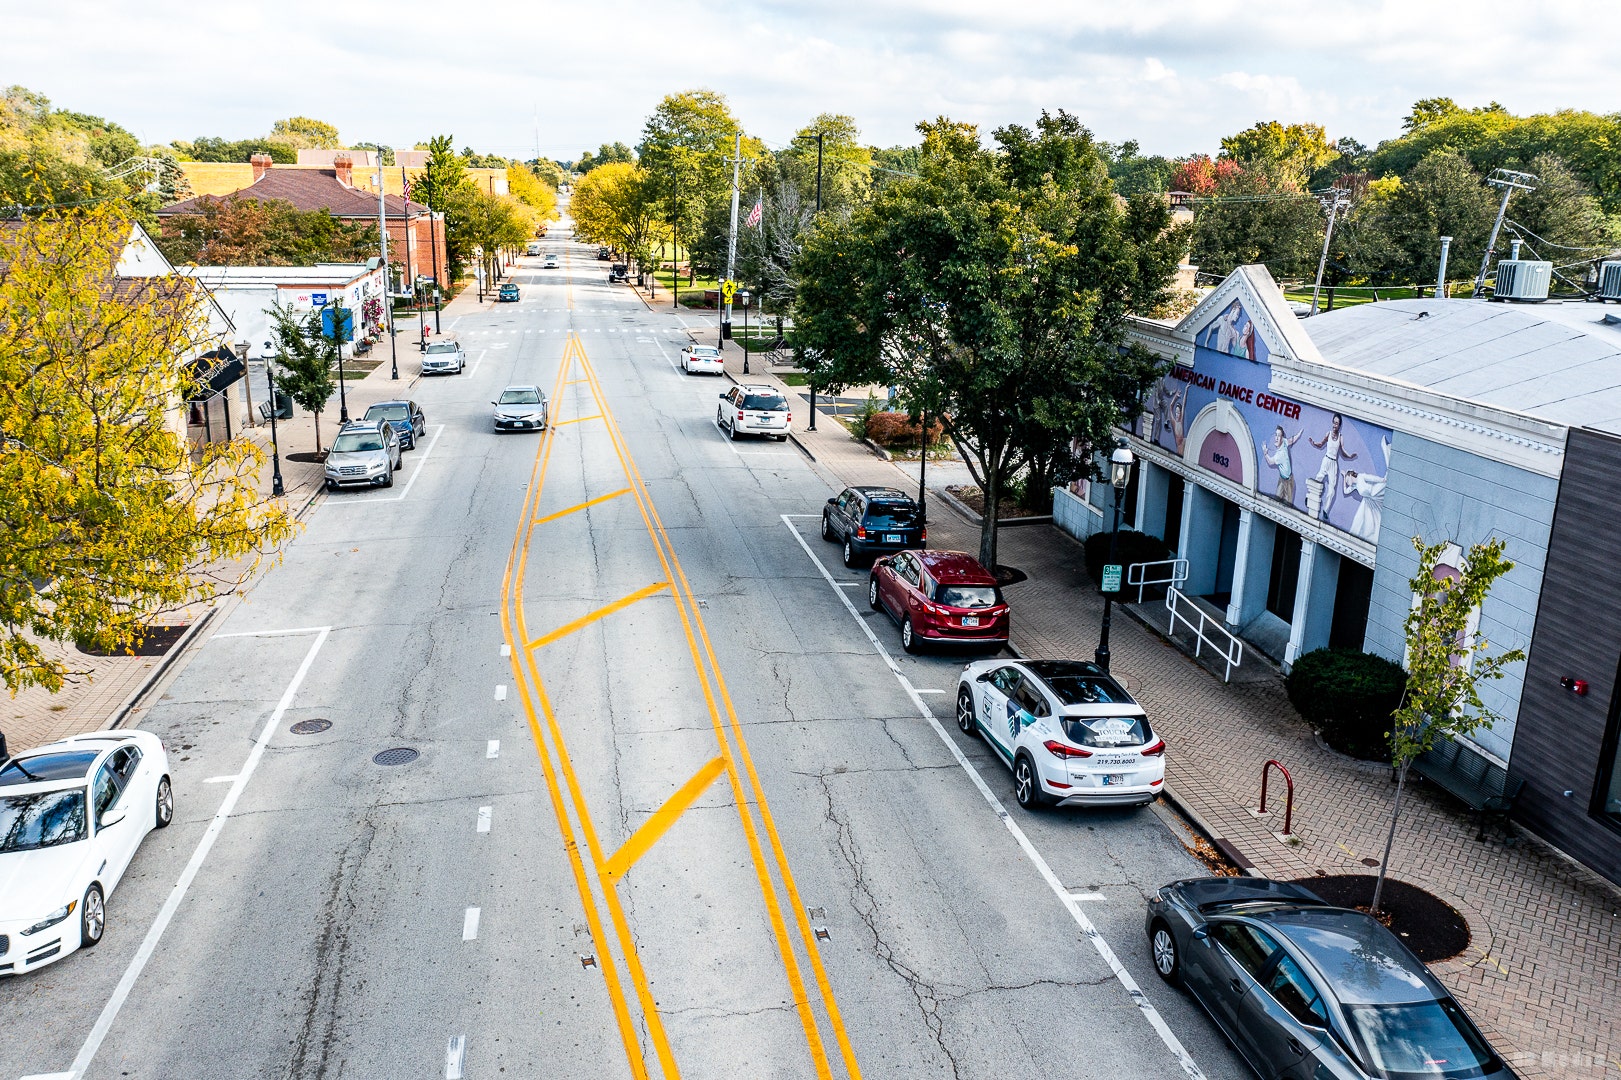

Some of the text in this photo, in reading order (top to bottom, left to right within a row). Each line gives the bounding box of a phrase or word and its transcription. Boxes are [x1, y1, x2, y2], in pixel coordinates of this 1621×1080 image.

[1169, 366, 1301, 419] AMERICAN DANCE CENTER
[1213, 452, 1229, 467] 1933
